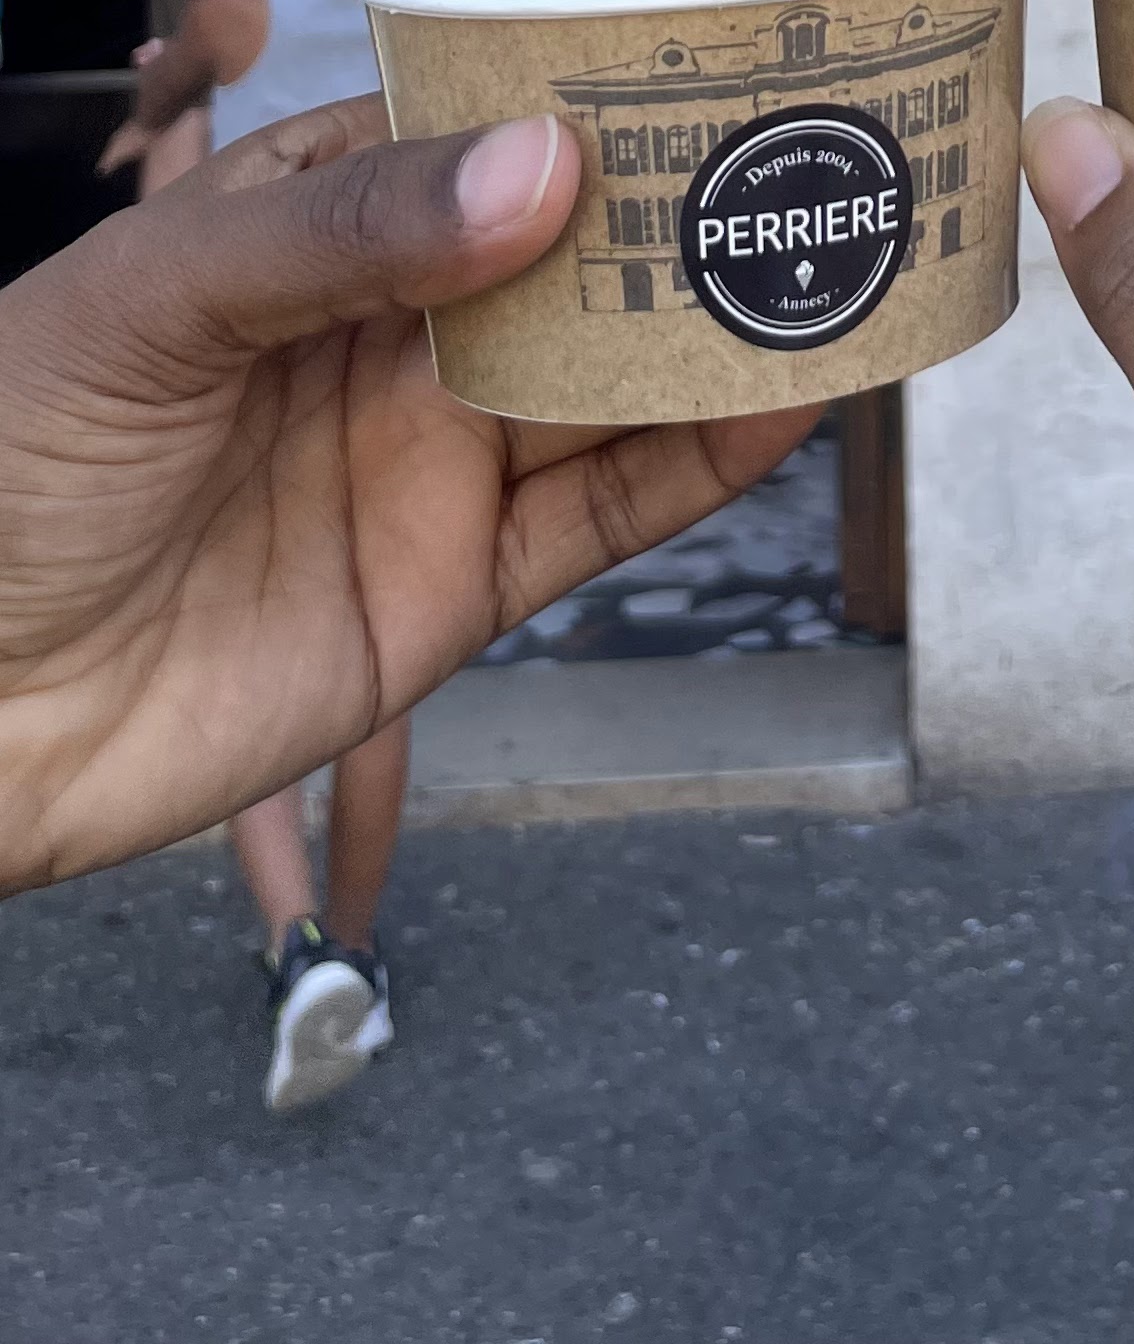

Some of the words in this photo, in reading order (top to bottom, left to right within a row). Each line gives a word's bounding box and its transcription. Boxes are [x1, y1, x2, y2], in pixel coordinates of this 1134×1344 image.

[745, 147, 811, 185] Depuis
[815, 149, 853, 175] 2004
[699, 188, 898, 259] PERRIERE
[778, 290, 831, 310] Annecy
